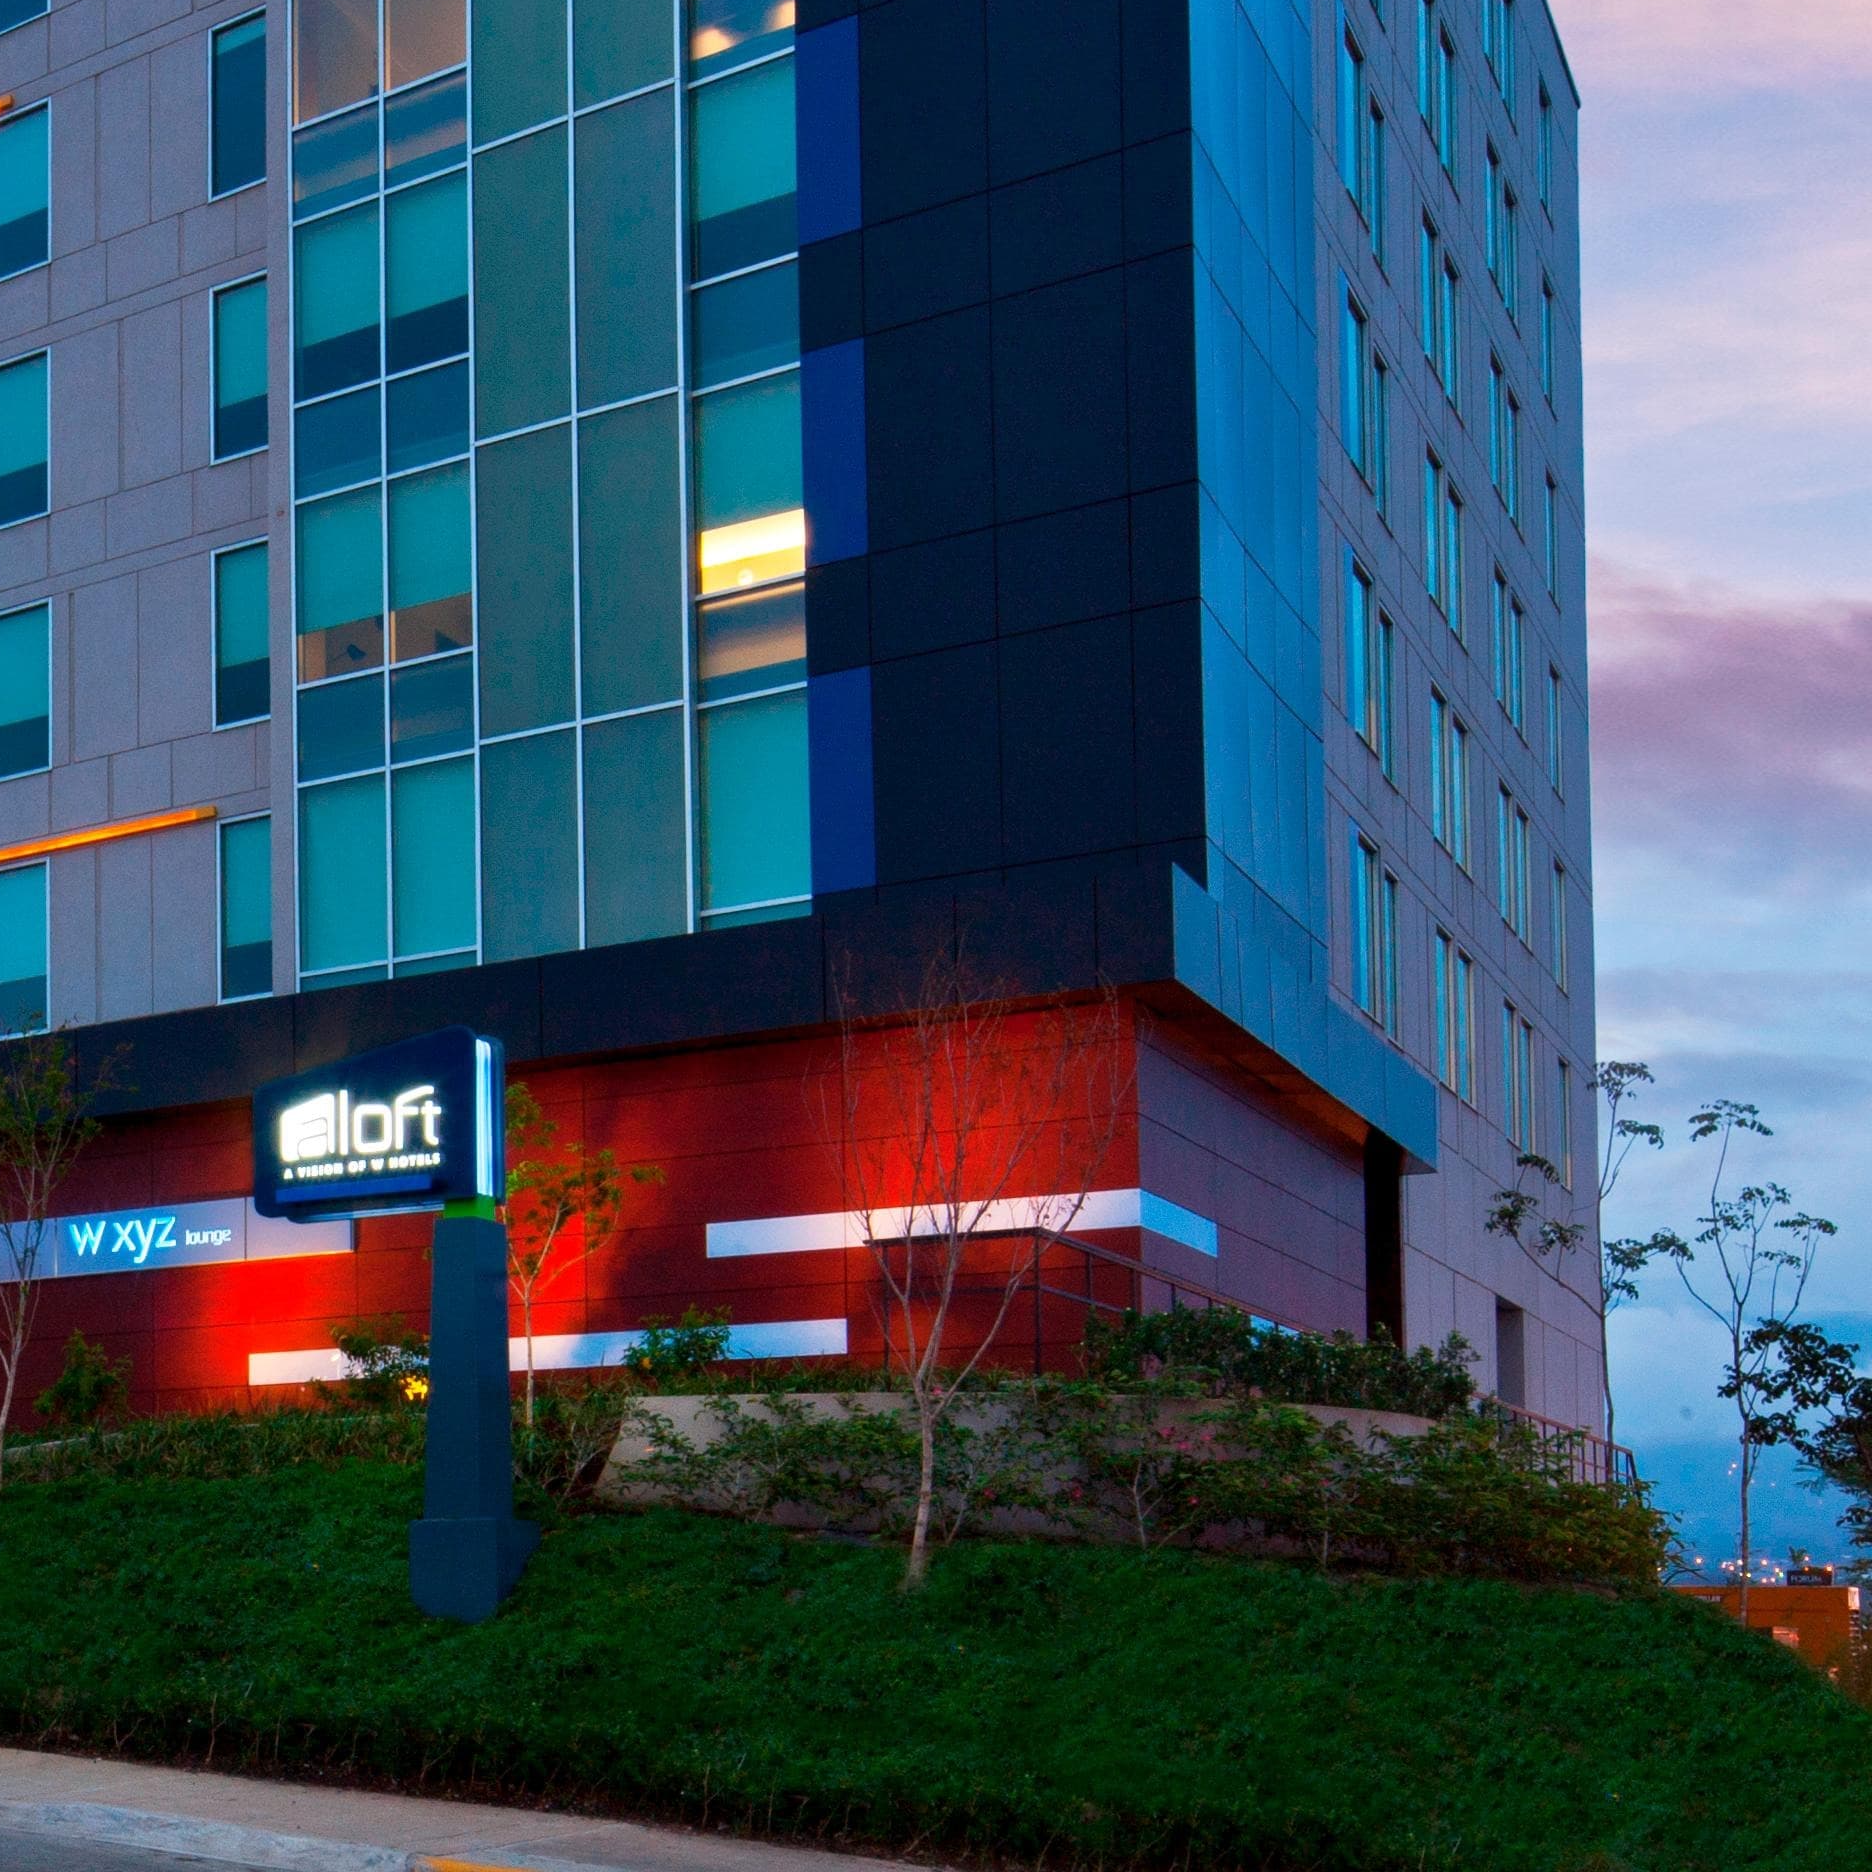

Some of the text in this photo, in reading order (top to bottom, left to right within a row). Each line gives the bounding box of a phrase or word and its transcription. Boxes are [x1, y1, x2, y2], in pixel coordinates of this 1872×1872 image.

[281, 1085, 442, 1163] aloft
[283, 1152, 441, 1180] A VISION OF W HOTELS
[185, 1229, 232, 1246] lounge
